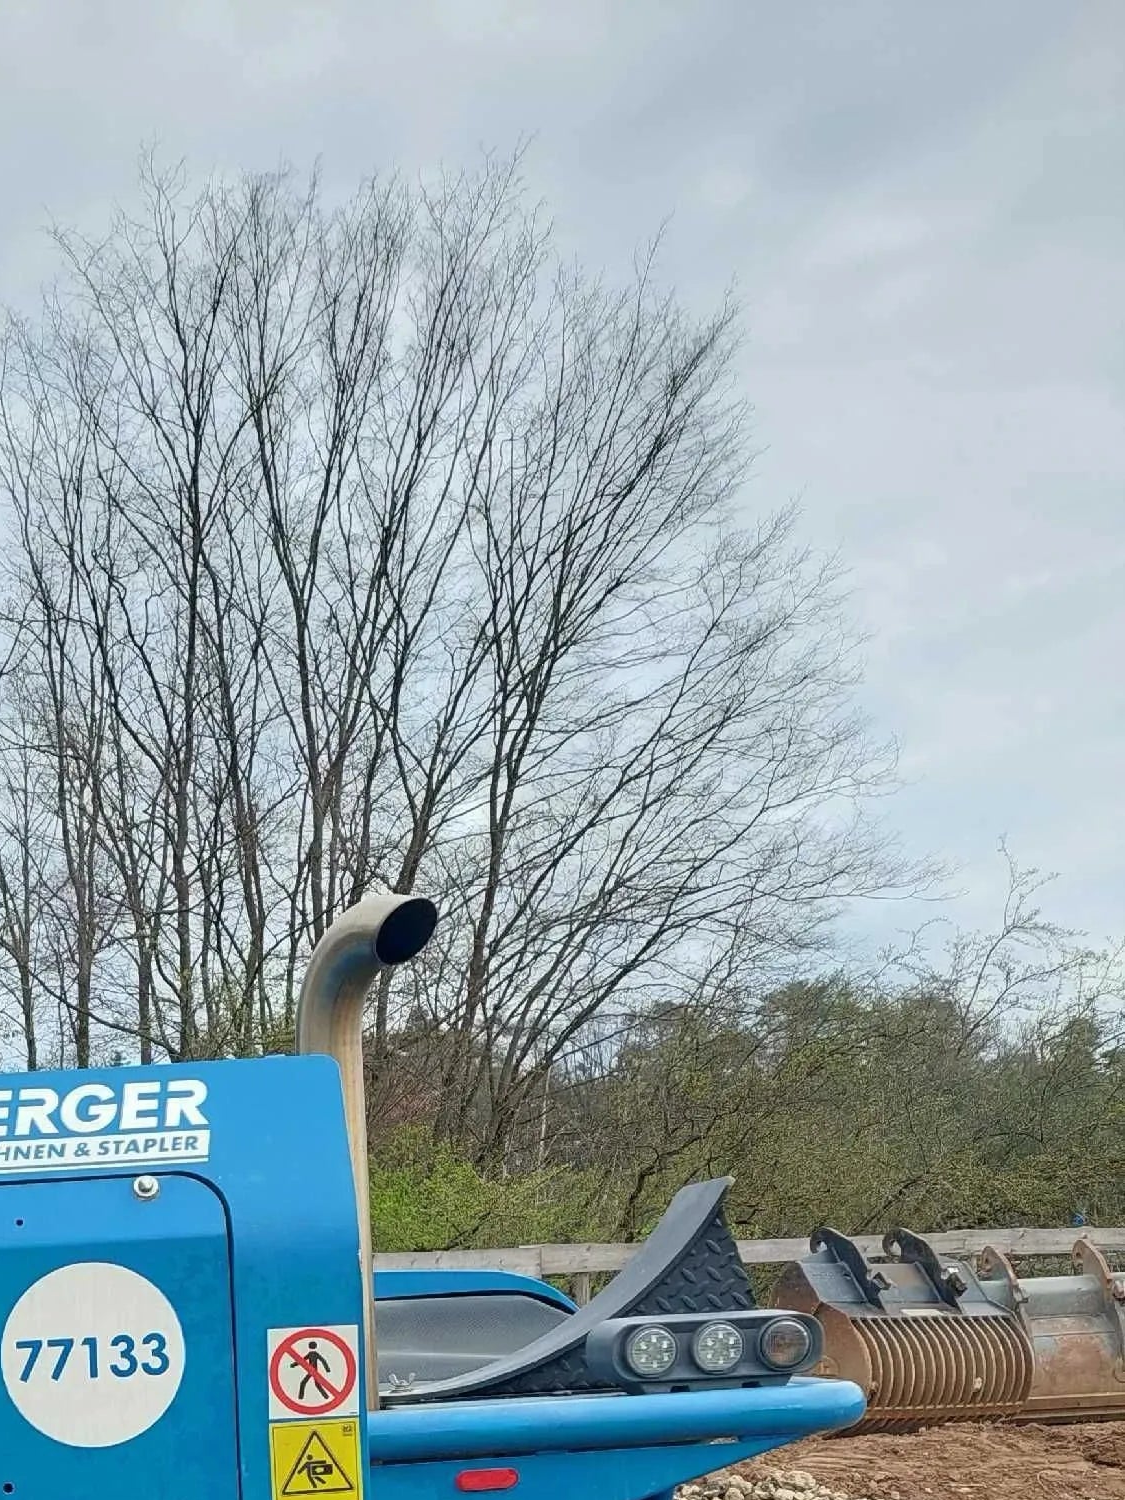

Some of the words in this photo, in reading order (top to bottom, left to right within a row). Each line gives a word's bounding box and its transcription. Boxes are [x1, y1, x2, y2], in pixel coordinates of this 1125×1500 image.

[73, 1141, 92, 1158] &
[96, 1134, 198, 1156] STAPLER
[15, 1332, 170, 1383] 77133
